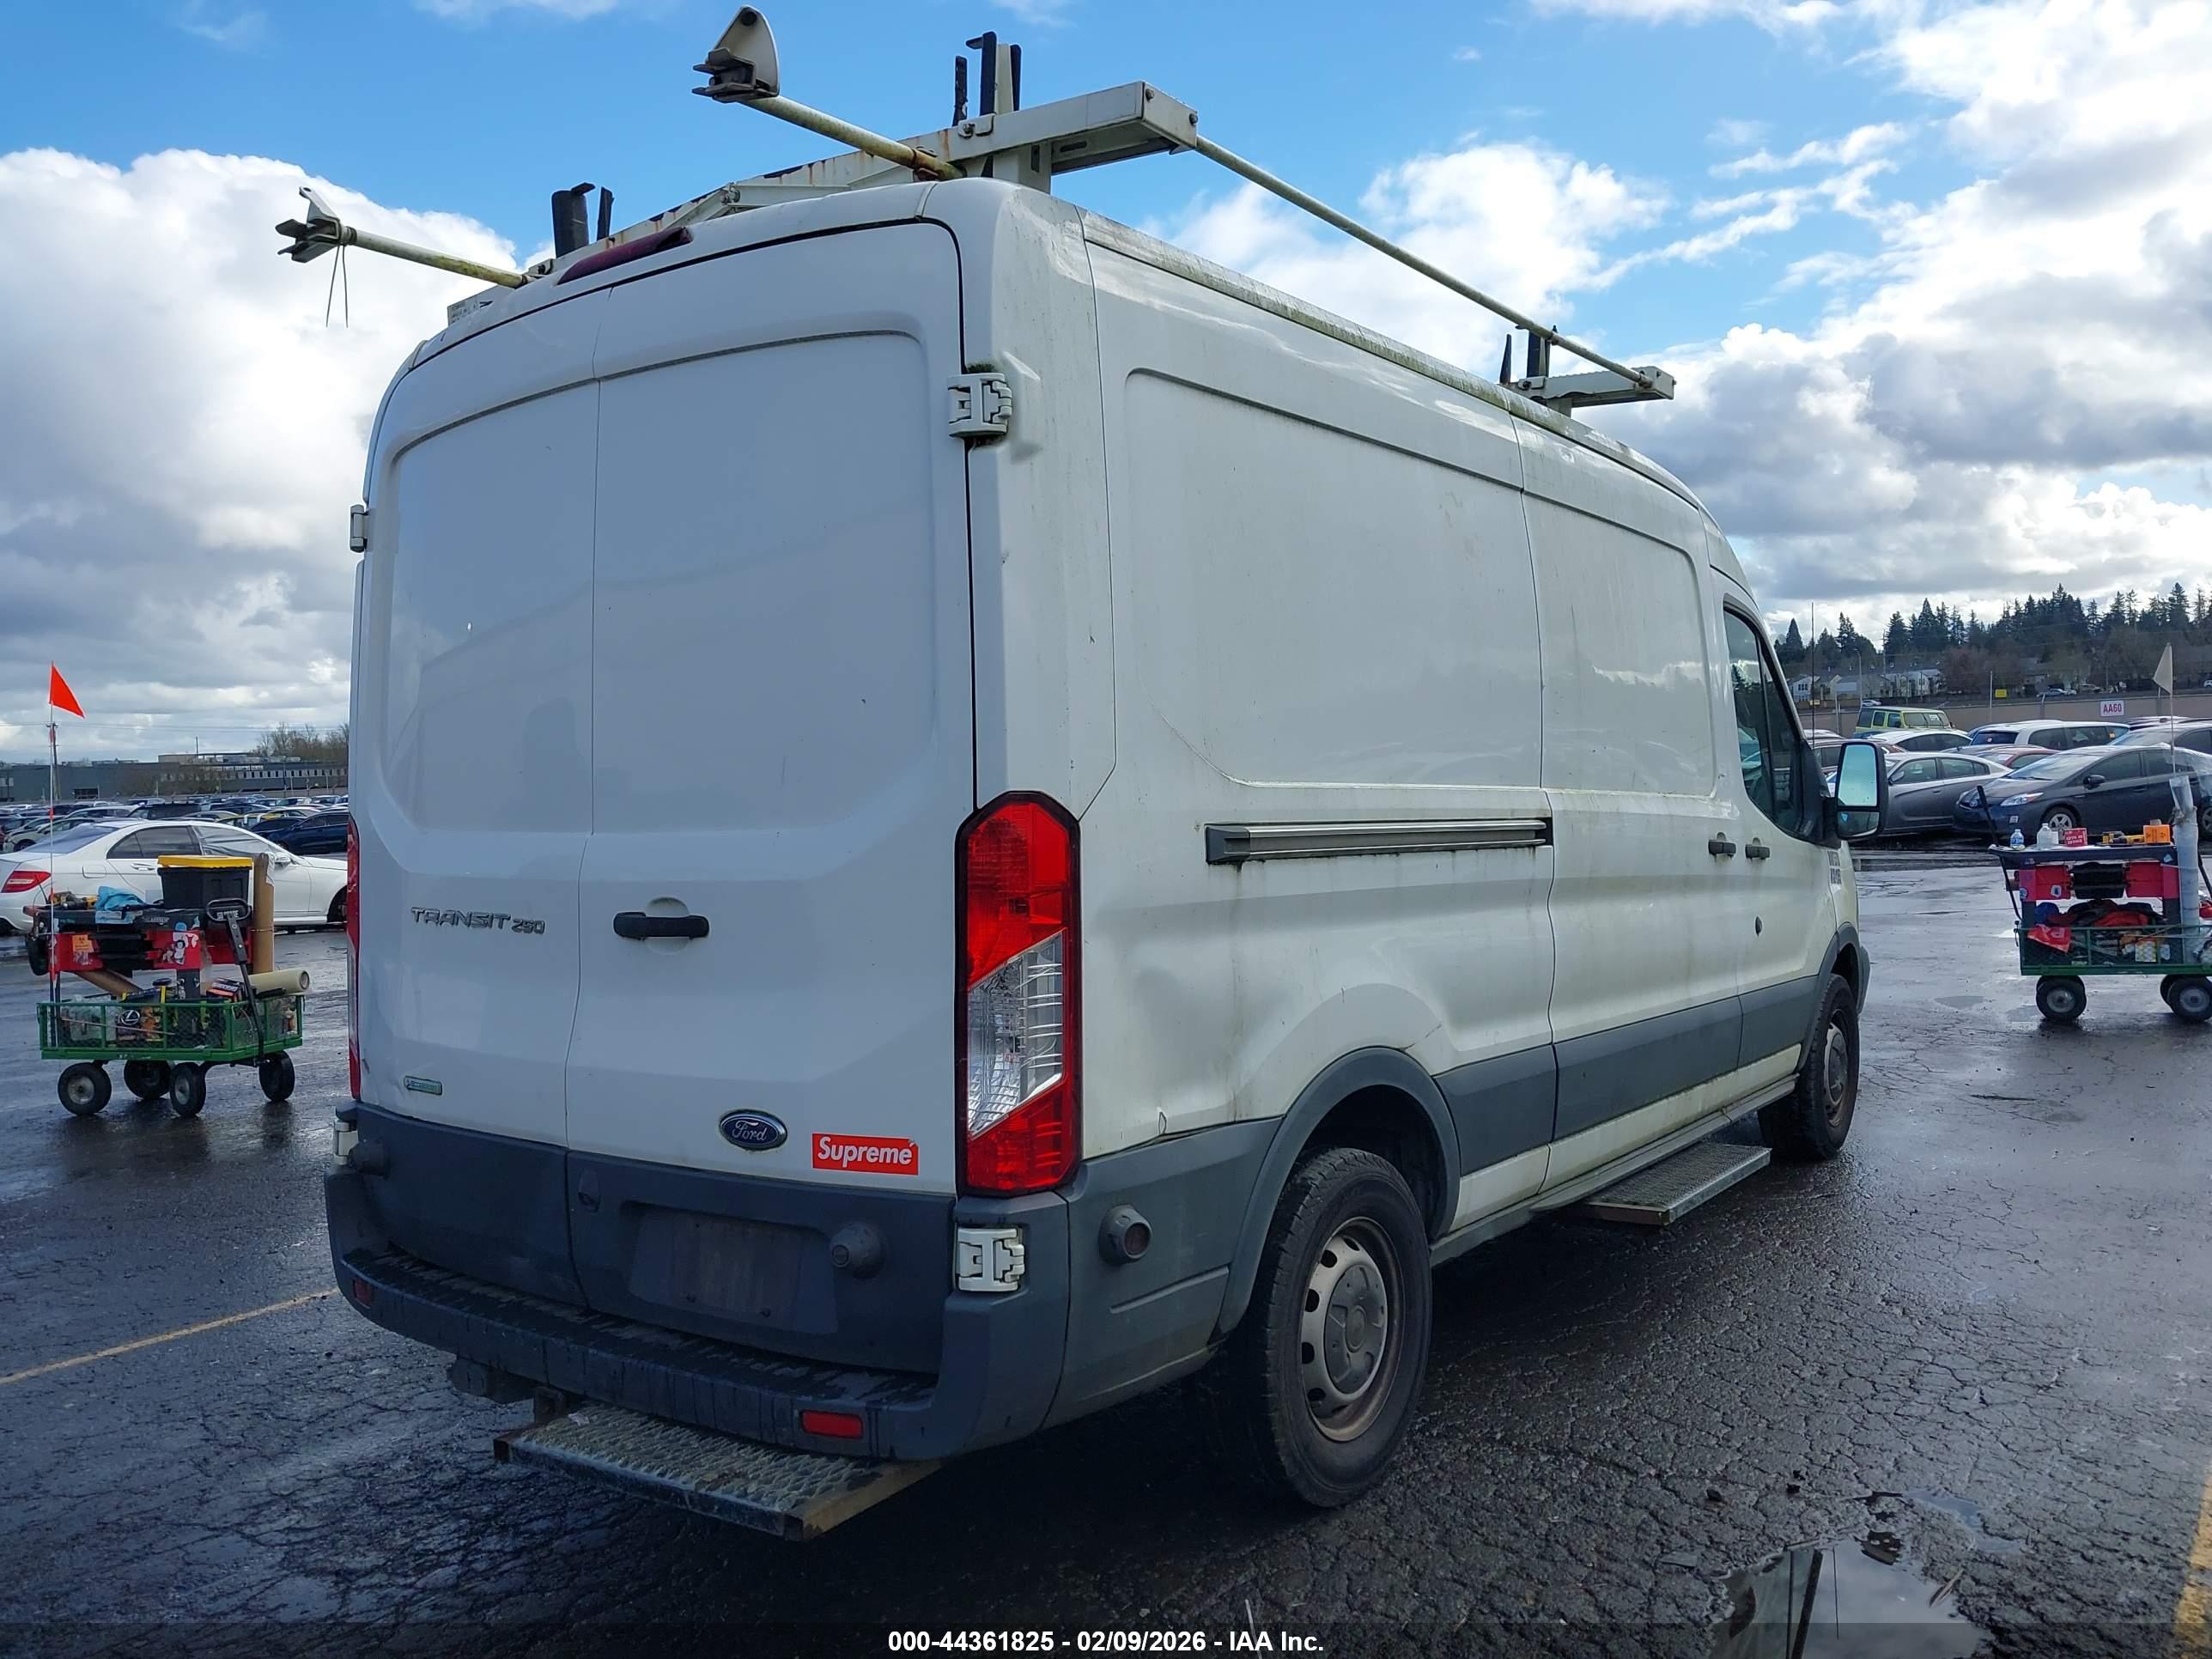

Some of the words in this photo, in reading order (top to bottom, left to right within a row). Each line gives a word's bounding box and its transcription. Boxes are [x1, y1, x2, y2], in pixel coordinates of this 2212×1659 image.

[2103, 703, 2122, 713] AA60
[410, 906, 511, 930] TRANSIT
[512, 918, 545, 934] 250
[731, 1120, 768, 1141] Ford
[817, 1136, 913, 1168] Supreme
